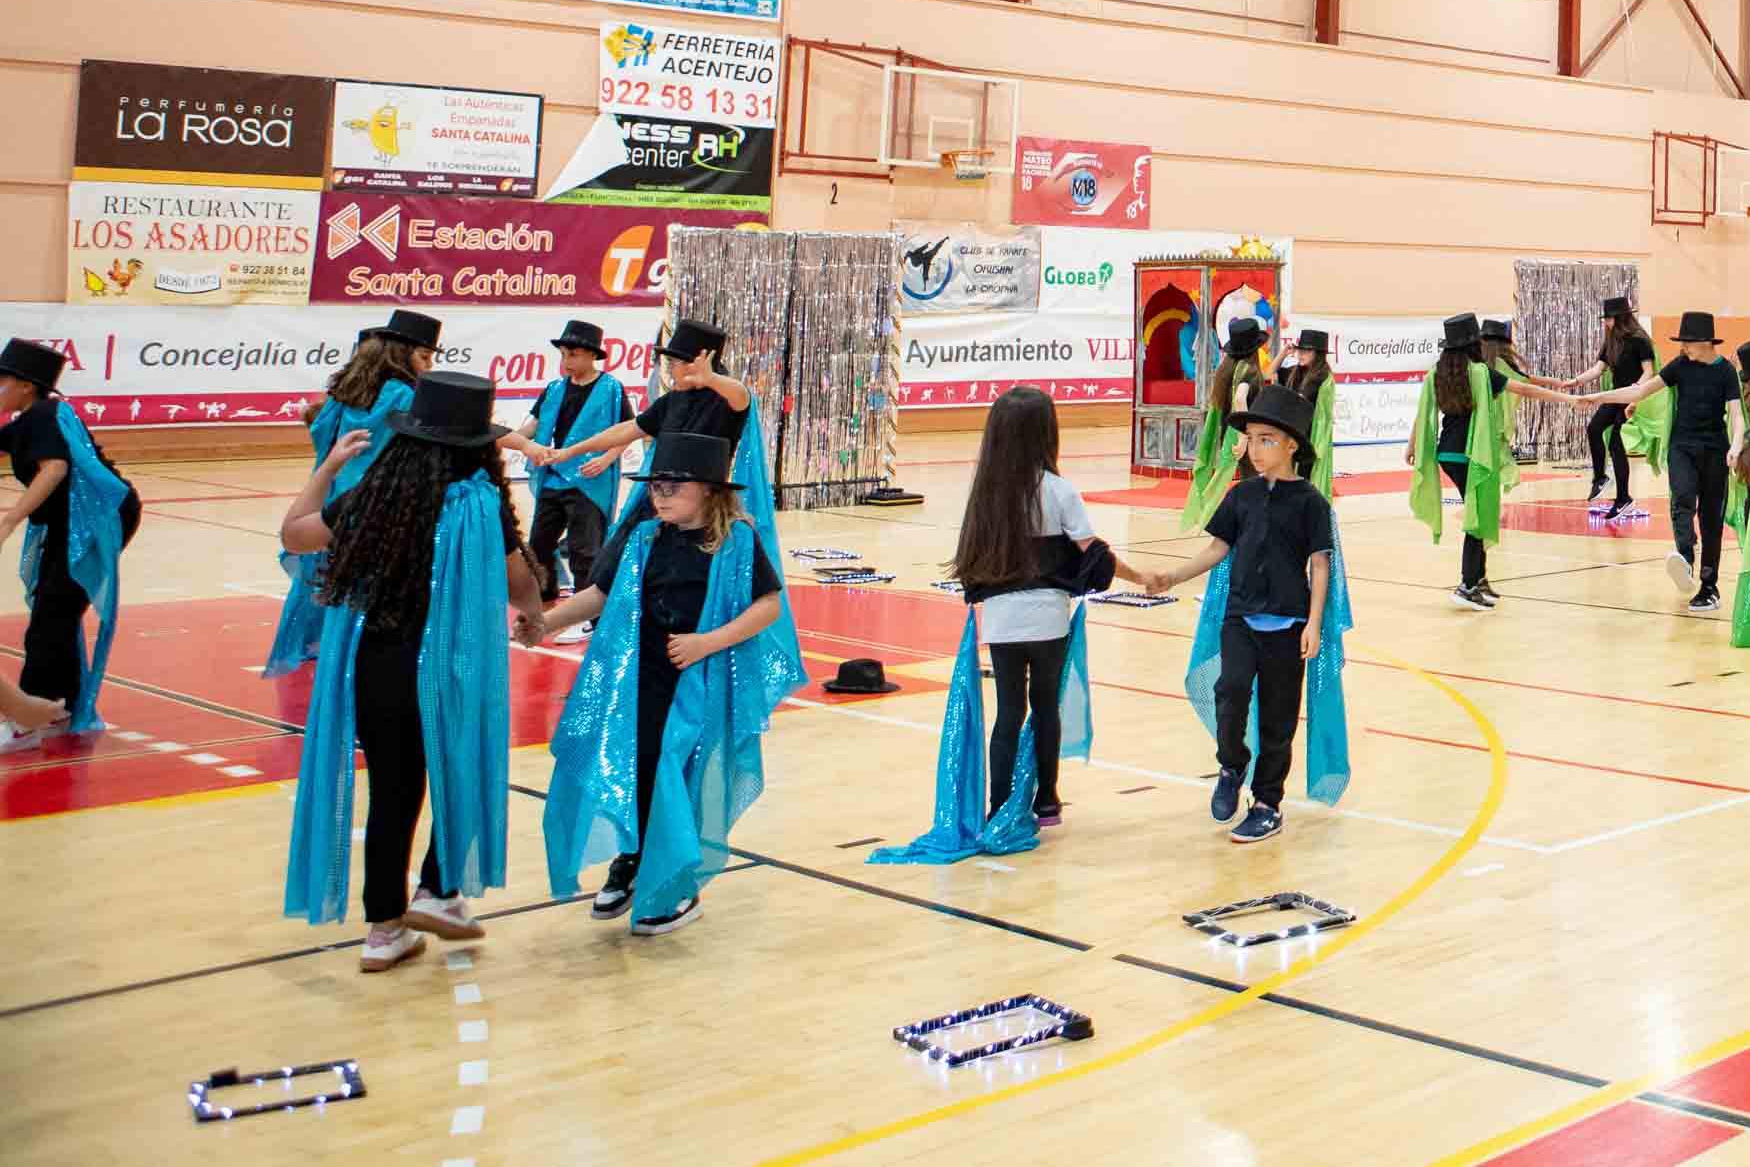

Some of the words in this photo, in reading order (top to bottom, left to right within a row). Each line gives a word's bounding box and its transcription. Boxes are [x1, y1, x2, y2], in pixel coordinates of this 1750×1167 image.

[661, 57, 773, 84] ACENTEJO
[601, 77, 650, 106] 922
[660, 84, 693, 111] 58
[706, 88, 735, 115] 13
[745, 93, 773, 119] 31
[431, 127, 470, 139] SANTA
[473, 131, 530, 145] CATALINA
[831, 183, 838, 204] 2
[1071, 178, 1096, 197] M18
[103, 195, 293, 220] RESTAURANTE
[73, 218, 133, 250] LOS
[144, 222, 310, 254] ASADORES
[407, 219, 554, 253] Estación
[345, 266, 443, 297] Santa
[452, 266, 577, 297] Catalina
[139, 341, 297, 371] Concejalía
[305, 342, 340, 365] de
[906, 338, 1073, 369] Ayuntamiento
[1348, 338, 1415, 358] Concejalía
[1418, 339, 1433, 354] de
[489, 352, 545, 384] con
